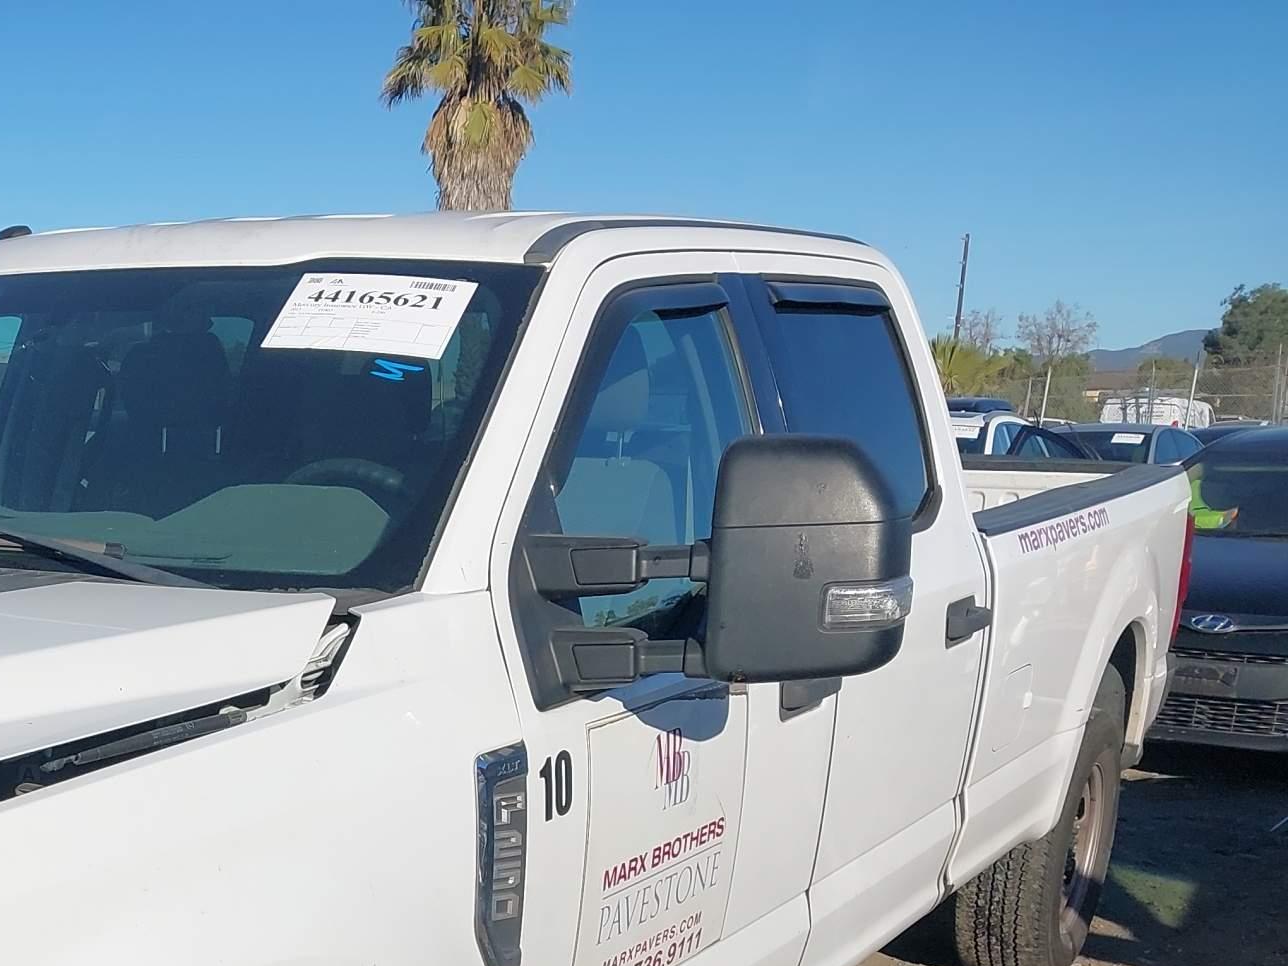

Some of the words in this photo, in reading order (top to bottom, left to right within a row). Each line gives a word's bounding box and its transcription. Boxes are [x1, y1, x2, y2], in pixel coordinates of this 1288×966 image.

[308, 289, 444, 310] 44165621
[1018, 506, 1110, 553] marxpavers.com
[539, 749, 572, 822] 10
[602, 852, 648, 891] MARX
[651, 817, 725, 868] BROTHERS
[597, 851, 721, 945] PAVESTONE
